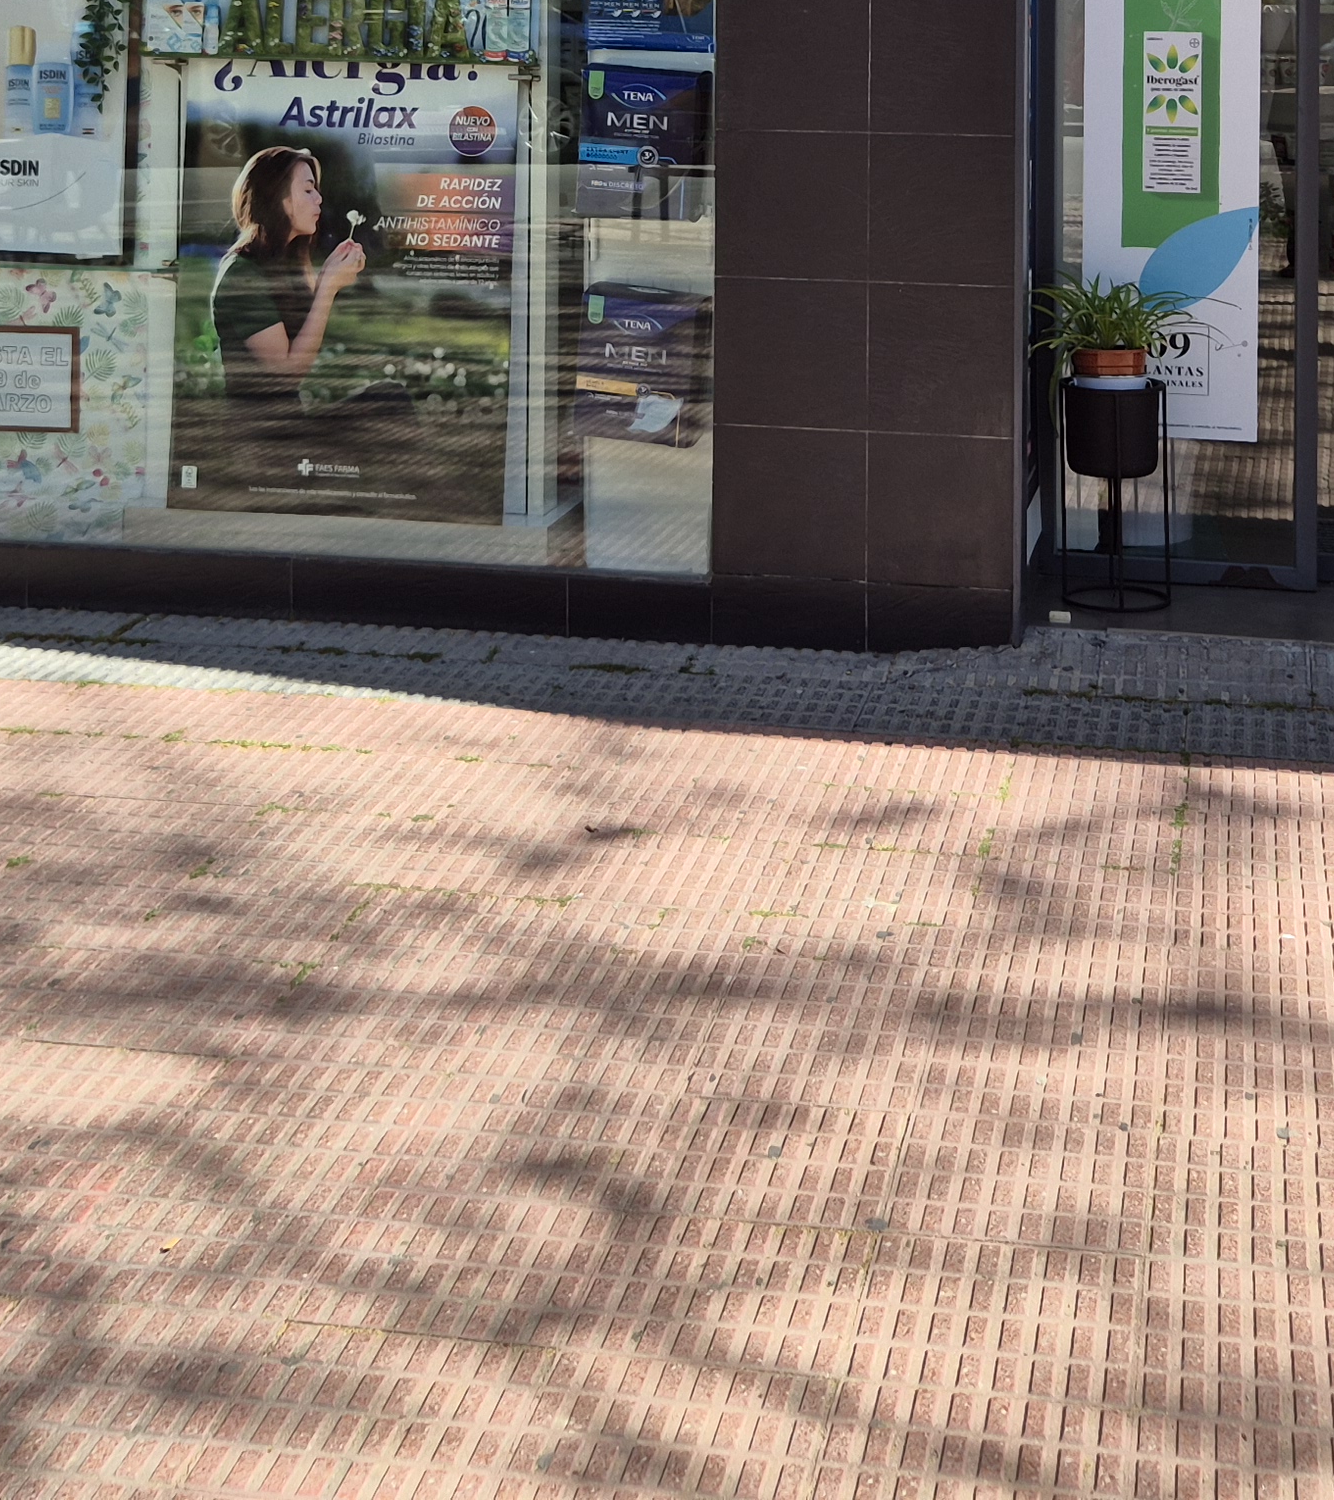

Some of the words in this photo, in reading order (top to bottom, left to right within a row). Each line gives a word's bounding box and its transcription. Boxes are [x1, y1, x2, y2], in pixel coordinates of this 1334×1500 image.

[39, 69, 67, 80] ISDIN
[1146, 74, 1198, 87] Iberogast
[8, 79, 30, 87] ISDIN
[622, 91, 654, 102] TENA
[279, 96, 419, 130] Astrilax
[455, 116, 491, 126] NUEVO
[606, 111, 668, 131] MEN
[357, 133, 415, 147] Bilastina
[451, 132, 492, 142] BILASTINA
[16, 177, 40, 187] SKIN
[439, 177, 503, 192] RAPIDEZ
[416, 195, 436, 207] DE
[438, 192, 502, 210] ACCIÓN
[375, 215, 501, 232] ANTIHISTAMÍNICO
[405, 233, 429, 246] NO
[432, 233, 500, 249] SEDANTE
[624, 319, 652, 331] TENA
[40, 346, 69, 366] EL
[604, 342, 667, 366] MEN
[13, 370, 42, 389] de
